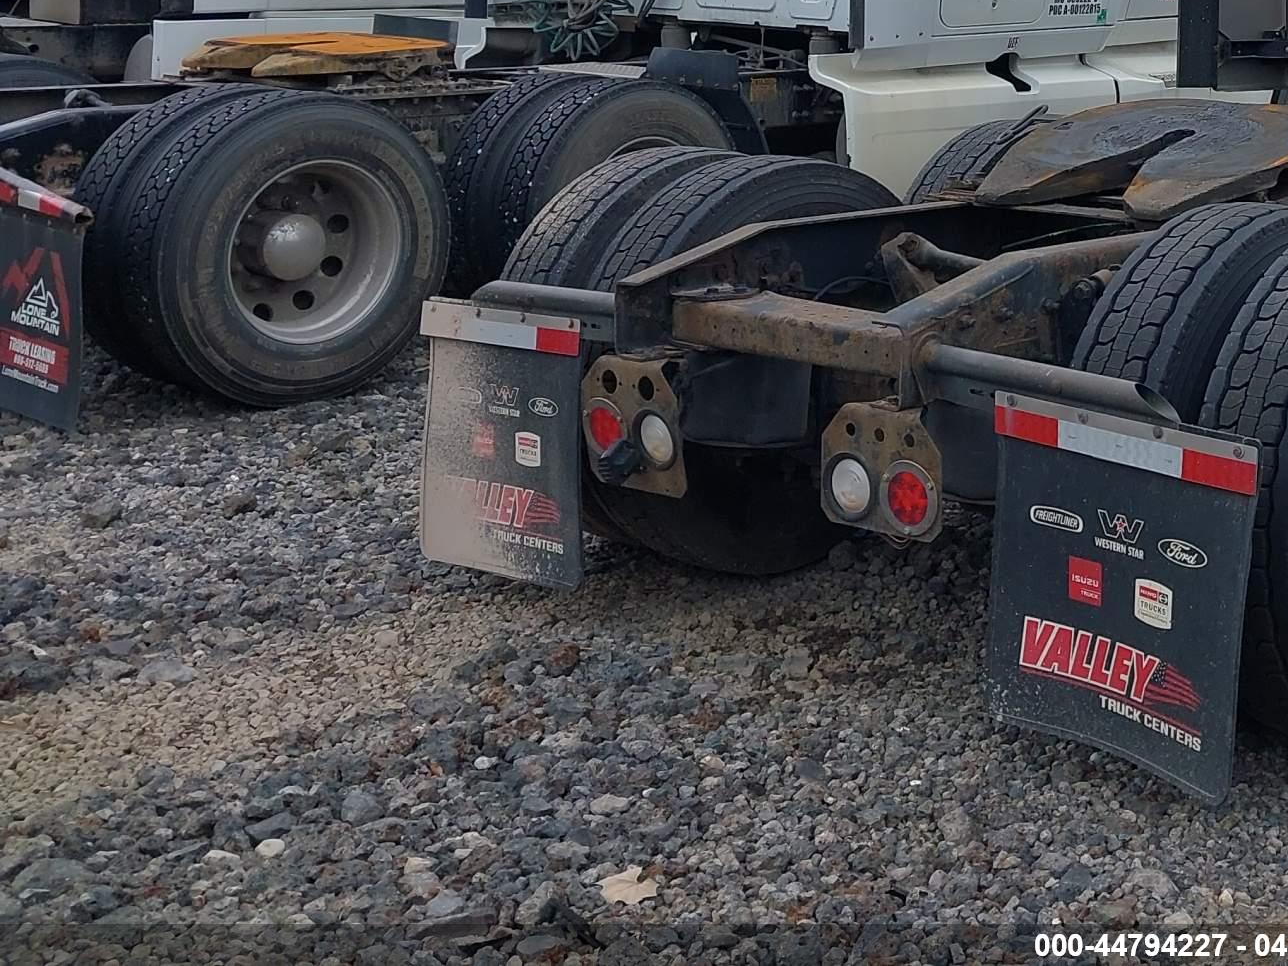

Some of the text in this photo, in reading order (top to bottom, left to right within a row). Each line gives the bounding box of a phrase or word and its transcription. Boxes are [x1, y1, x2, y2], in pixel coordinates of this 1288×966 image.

[21, 301, 48, 319] LONE
[10, 310, 60, 336] MOUNTAIN
[8, 336, 56, 365] TRUCK LEASING
[534, 400, 554, 414] Ford
[1034, 509, 1079, 529] FREIGHTLINER
[523, 535, 564, 555] CENTERS
[1094, 536, 1145, 560] WESTERN STAR
[1165, 541, 1198, 566] Ford
[1071, 574, 1099, 588] ISUZU
[1080, 588, 1099, 600] TRUCK
[1139, 600, 1168, 616] TRUCKS
[1019, 616, 1160, 703] VALLEY
[1099, 694, 1202, 752] TRUCK CENTERS
